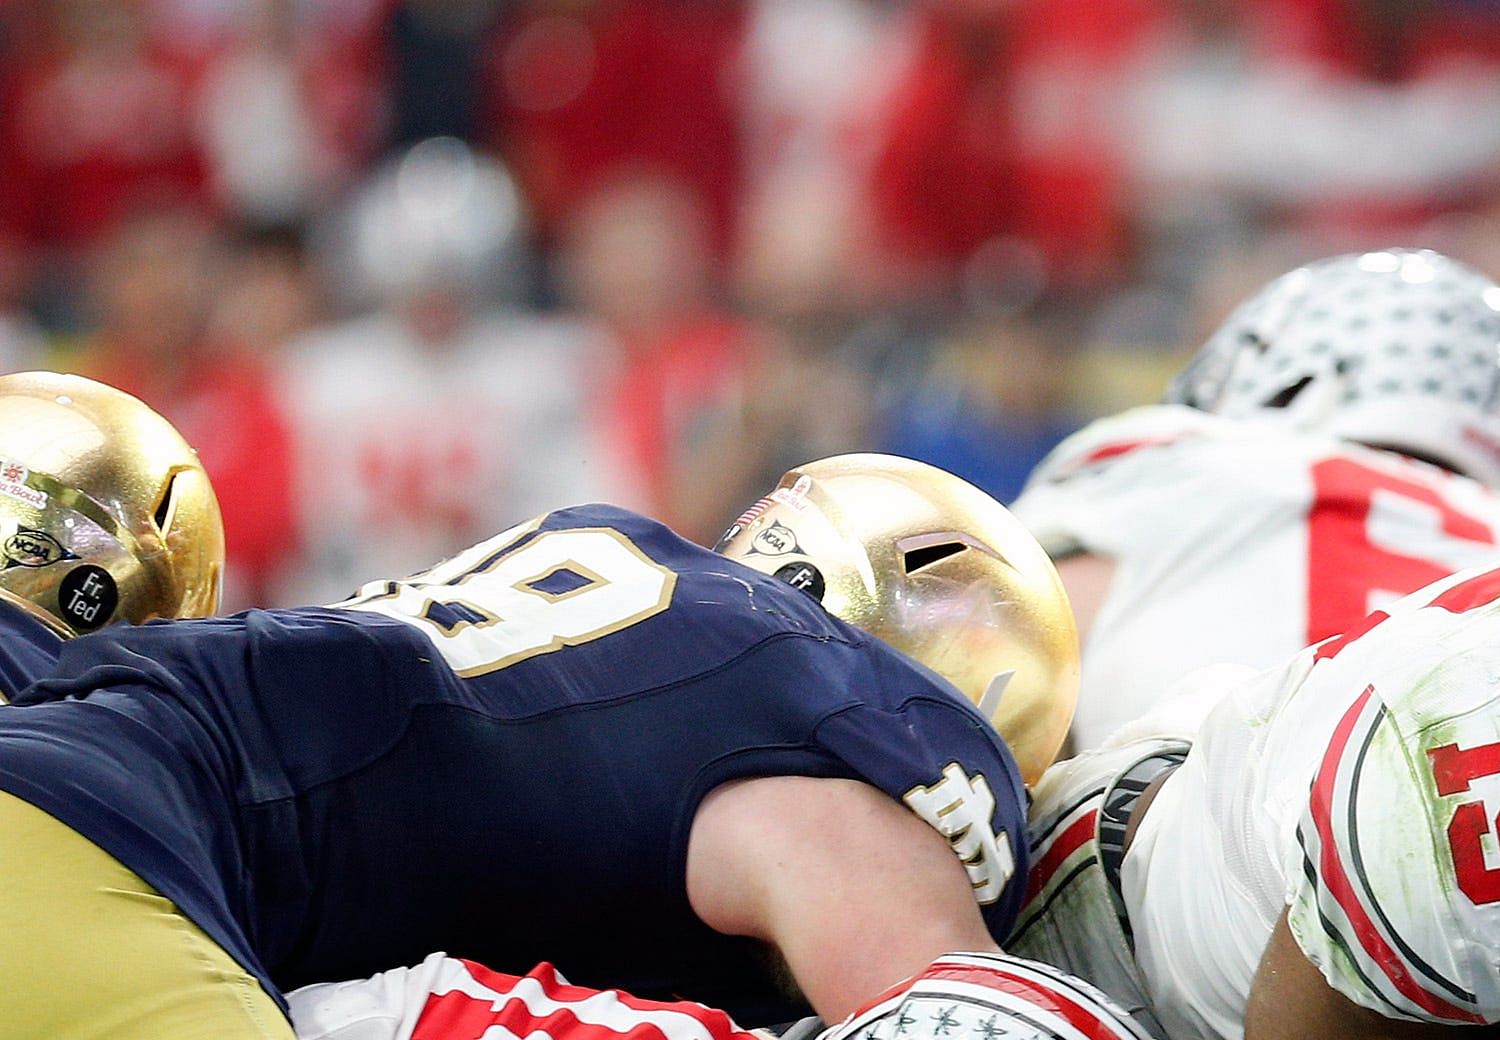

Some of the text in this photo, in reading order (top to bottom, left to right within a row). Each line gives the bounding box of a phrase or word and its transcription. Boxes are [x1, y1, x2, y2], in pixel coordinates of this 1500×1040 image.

[12, 538, 51, 559] NCAA
[761, 531, 786, 551] NCAA
[81, 572, 104, 599] Fr.
[67, 590, 101, 623] Ted
